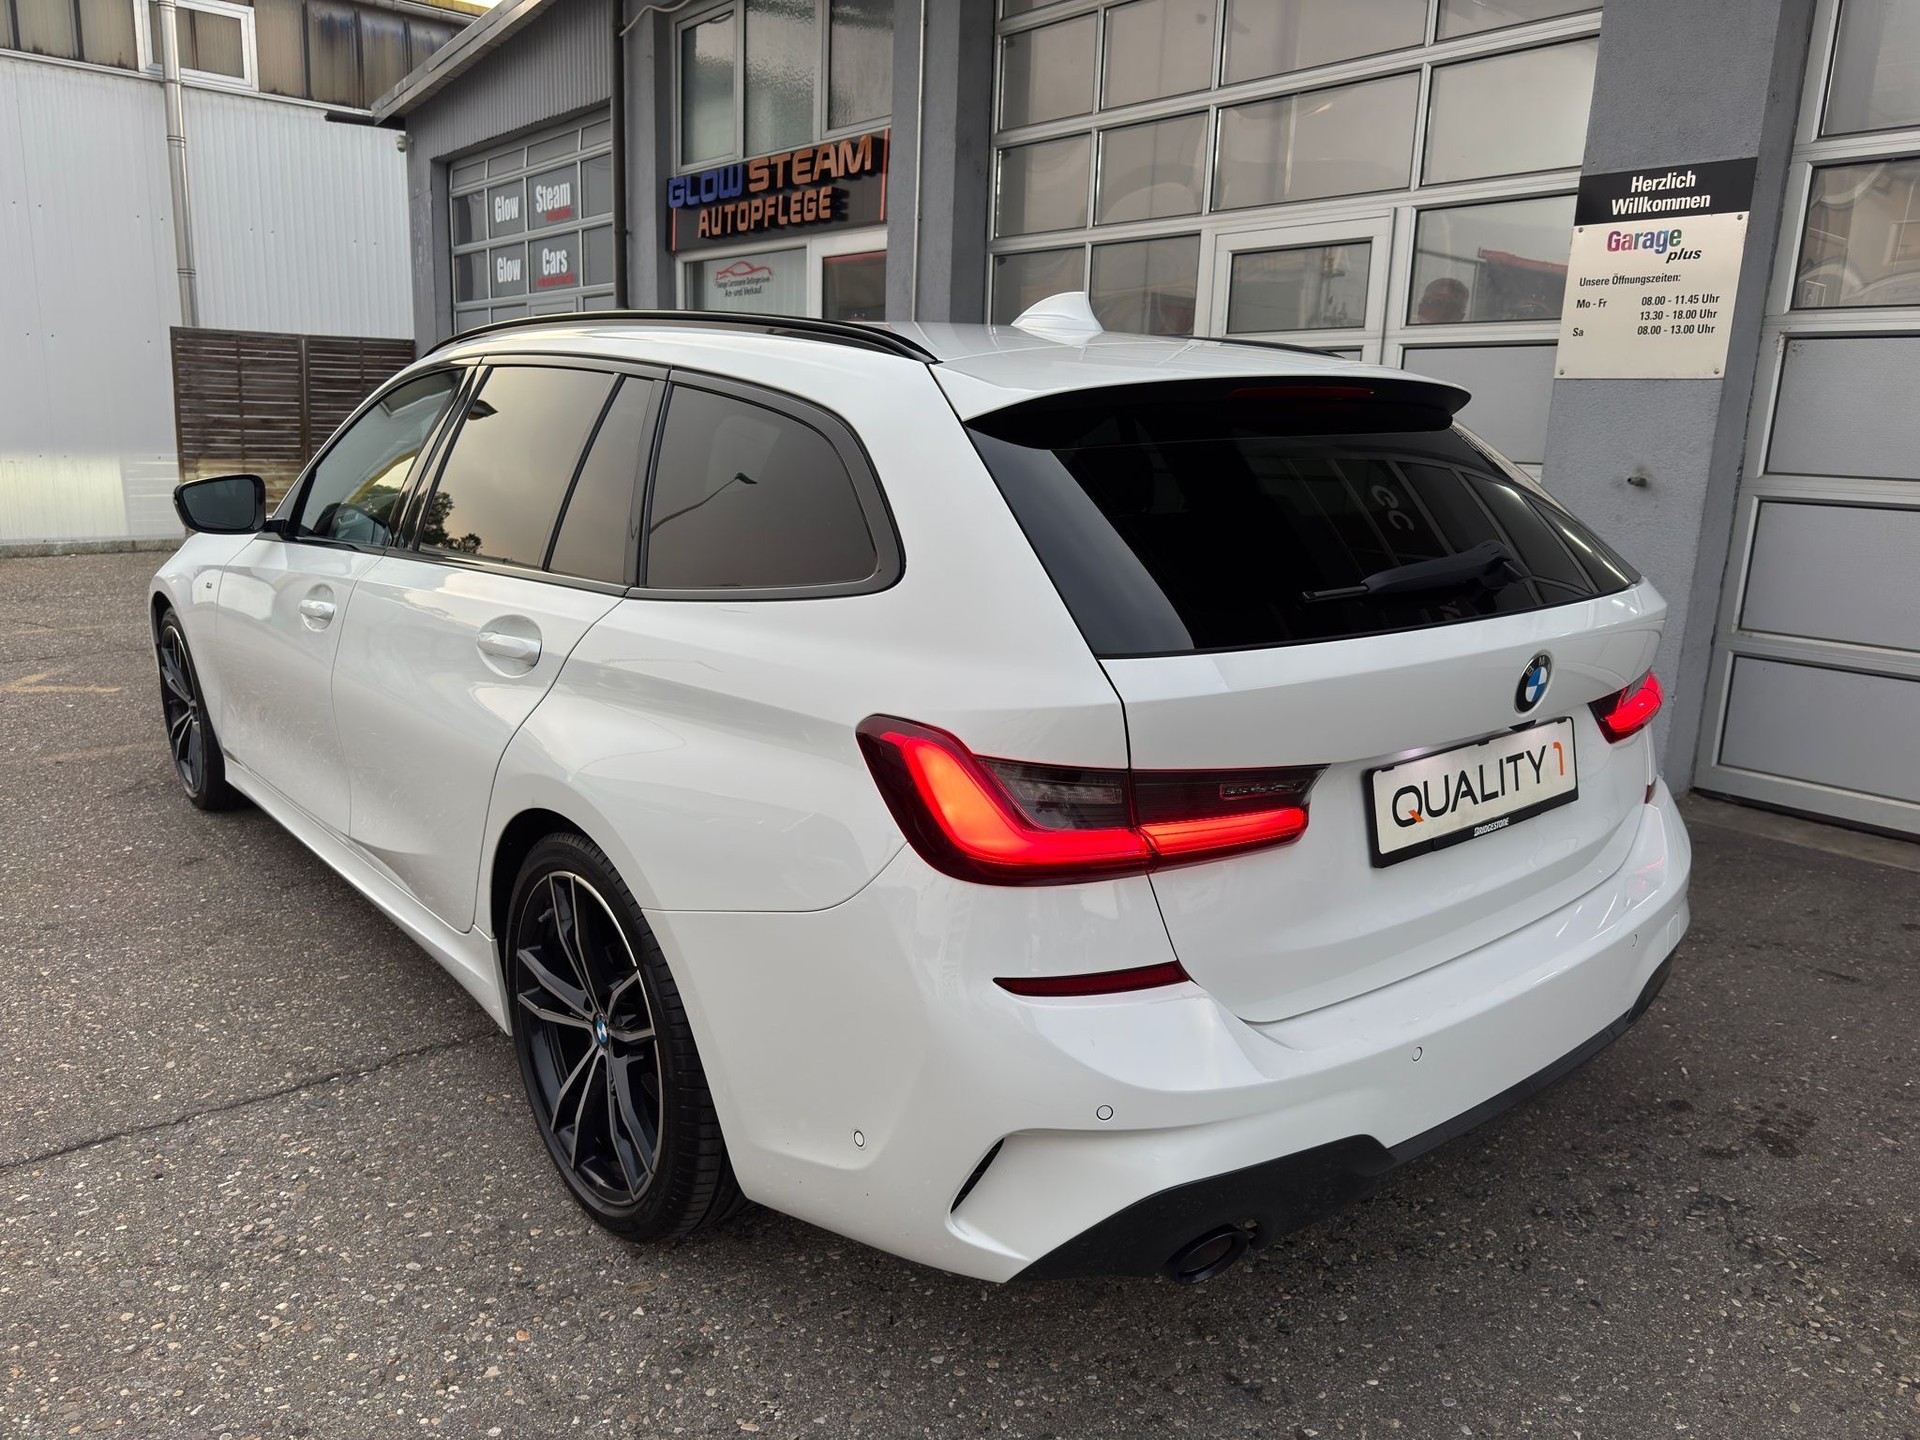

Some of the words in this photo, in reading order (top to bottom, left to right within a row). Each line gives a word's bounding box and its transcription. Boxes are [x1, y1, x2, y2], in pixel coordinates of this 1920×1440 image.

[668, 163, 743, 208] GLOW
[749, 134, 873, 192] STEAM
[1631, 170, 1697, 193] Herzlich
[494, 195, 519, 223] Glow
[536, 182, 571, 213] Steam
[698, 186, 833, 238] AUTOPFLEGE
[1611, 194, 1711, 216] Willkommen
[1607, 229, 1682, 255] Garage
[497, 256, 521, 283] Glow
[542, 247, 568, 276] Cars
[1666, 247, 1702, 264] plus
[1579, 277, 1610, 287] Unsere
[1612, 273, 1681, 286] Öffnungszeiten:
[1576, 299, 1591, 309] Mo
[1598, 298, 1607, 308] Fr
[1641, 296, 1666, 306] 08.00
[1674, 294, 1699, 305] 11.45
[1701, 293, 1720, 304] Uhr
[1640, 310, 1664, 321] 13.30
[1672, 309, 1697, 320] 18.00
[1699, 308, 1718, 319] Uhr
[1572, 327, 1584, 337] Sa
[1637, 325, 1661, 335] 08.00
[1670, 324, 1695, 335] 13.00
[1697, 323, 1715, 334] Uhr
[1473, 817, 1510, 837] BRIDGESTONE
